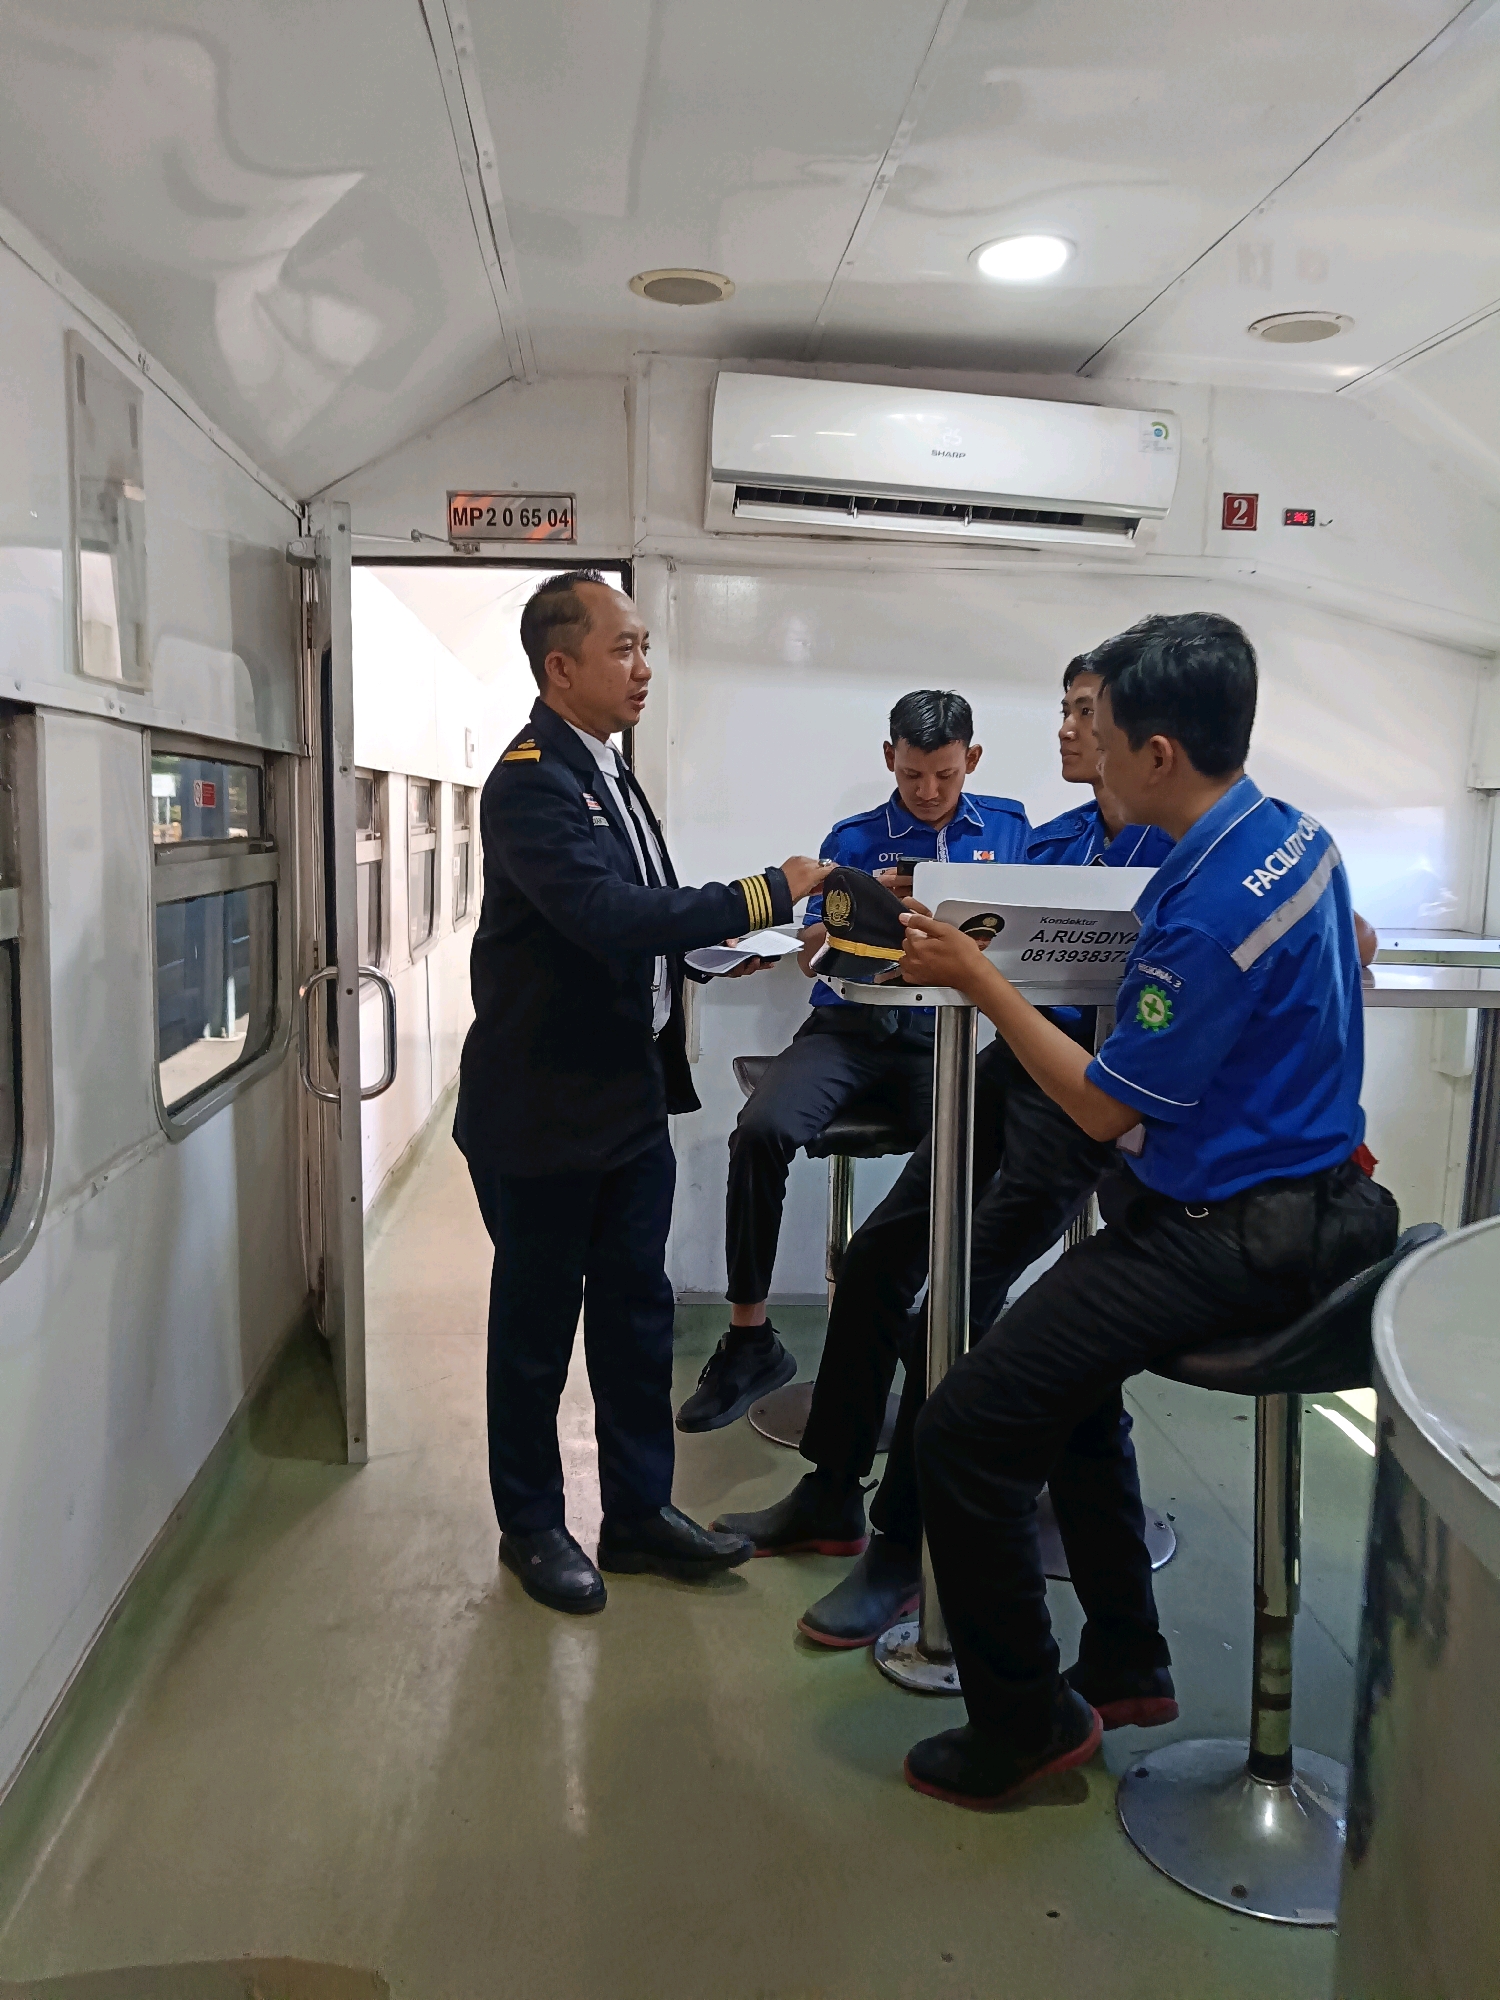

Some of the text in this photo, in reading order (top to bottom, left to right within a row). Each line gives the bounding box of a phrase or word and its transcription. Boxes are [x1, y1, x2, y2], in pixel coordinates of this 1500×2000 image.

[931, 449, 967, 459] SHARP
[519, 508, 542, 528] 65
[547, 508, 570, 528] 04
[1231, 498, 1249, 526] 2
[1242, 829, 1307, 897] FACILITY
